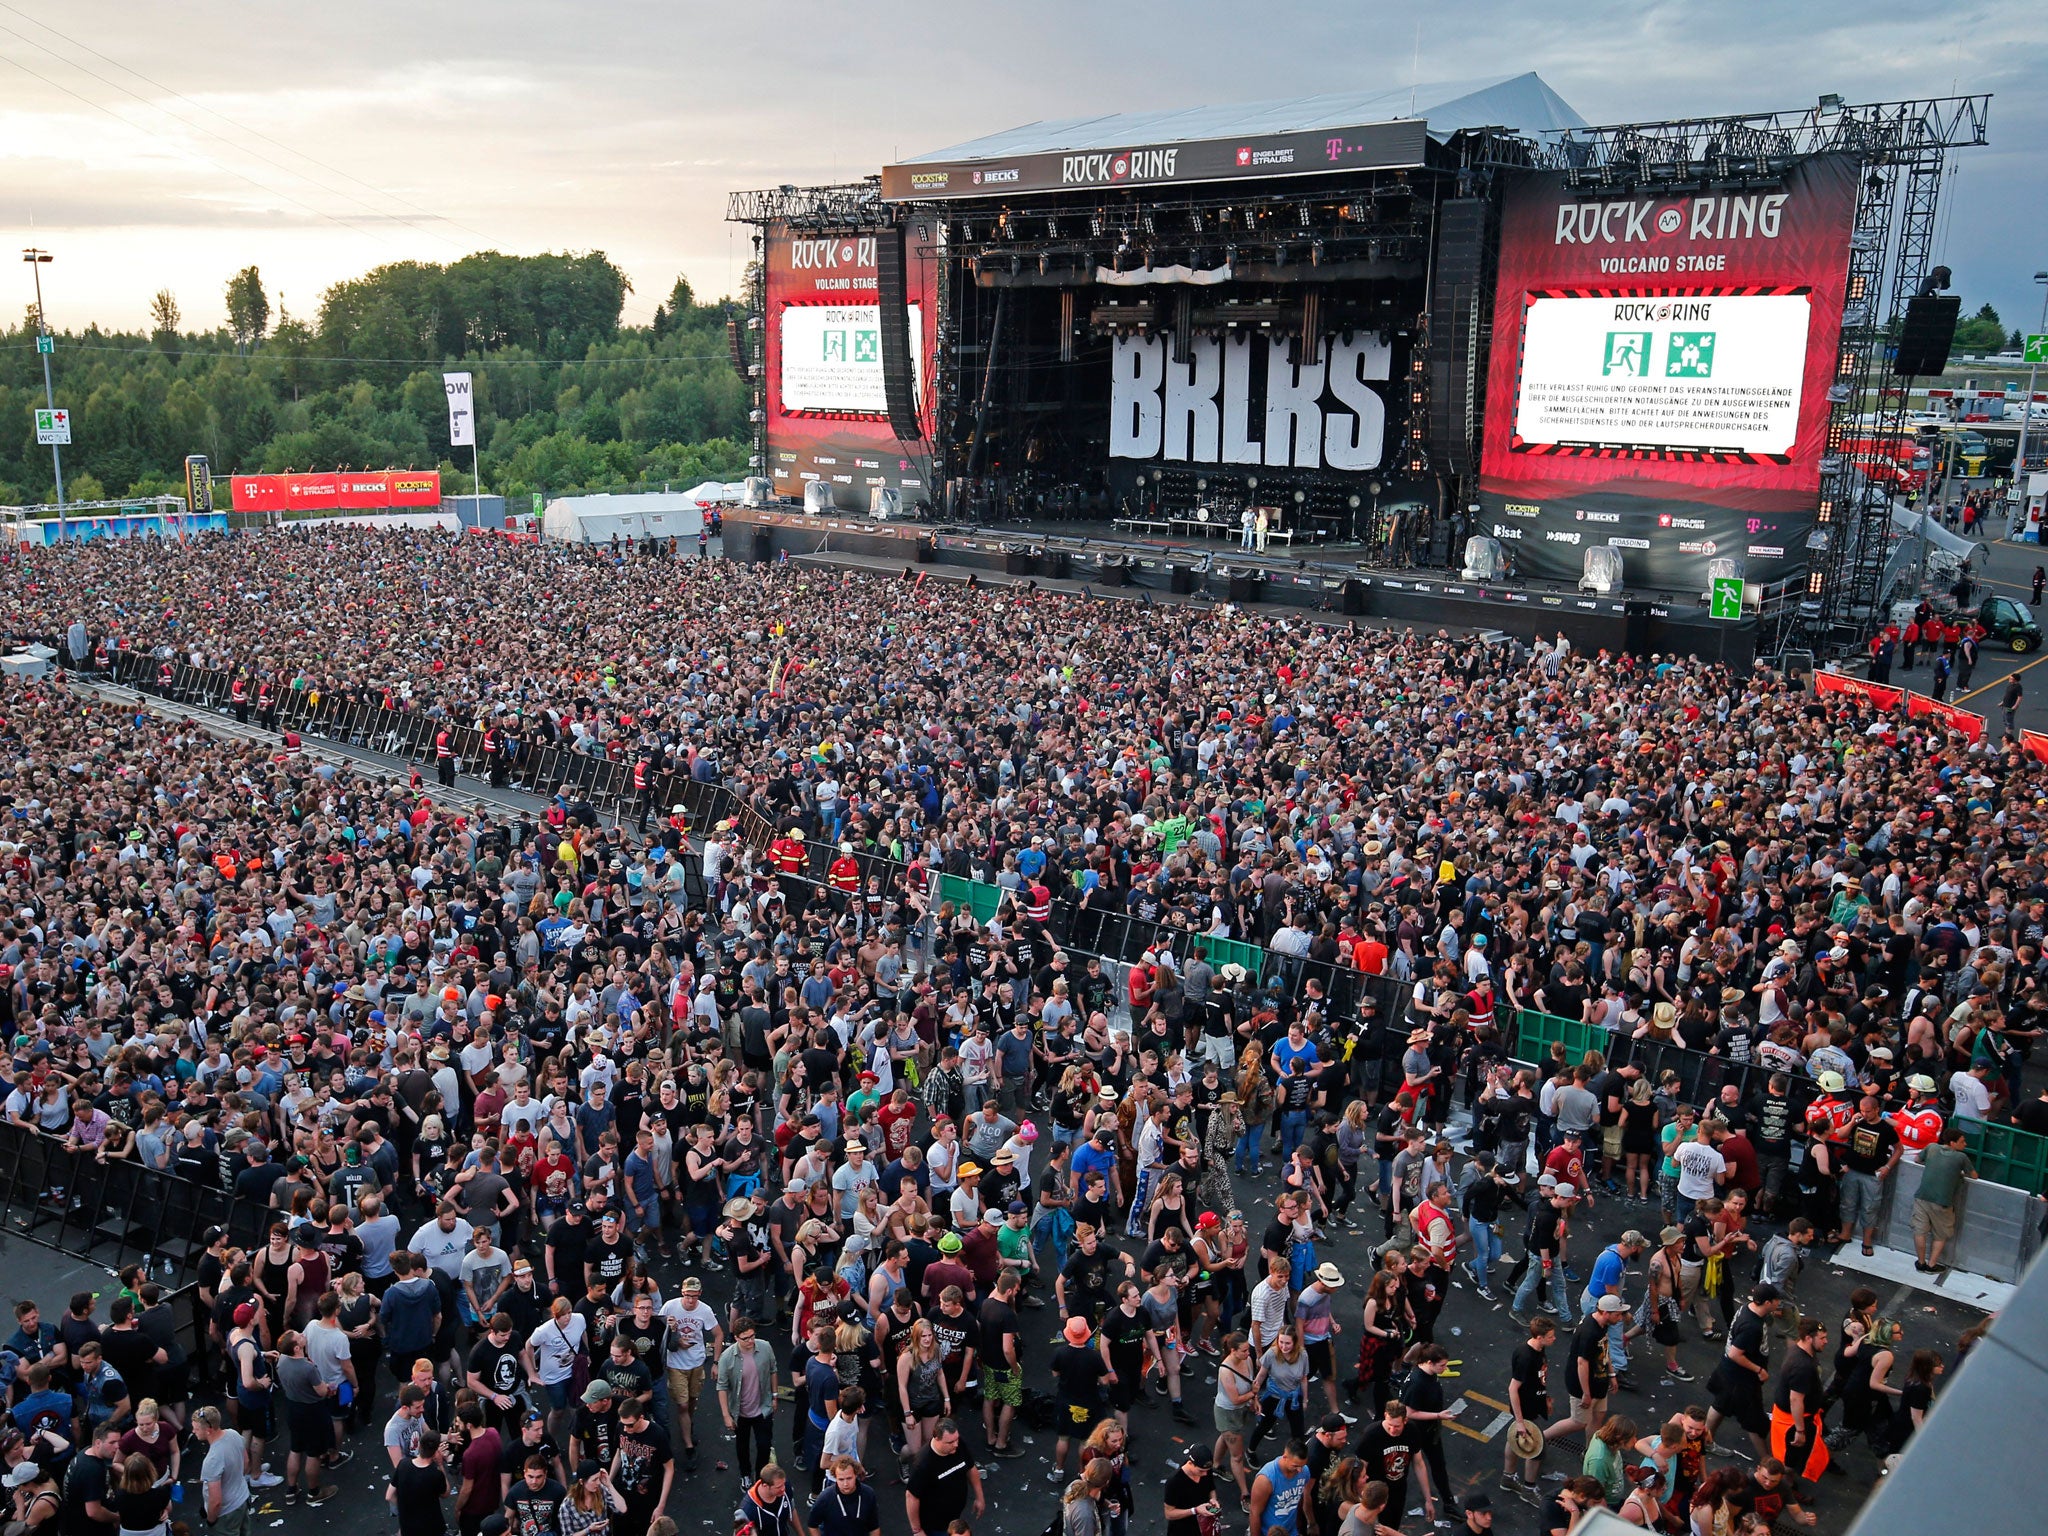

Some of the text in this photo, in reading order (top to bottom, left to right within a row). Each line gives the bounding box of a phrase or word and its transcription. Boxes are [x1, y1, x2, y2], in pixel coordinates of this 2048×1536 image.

[1252, 149, 1294, 158] ENGELBERT
[1062, 154, 1113, 183] ROCK
[1130, 149, 1178, 178] RING
[1252, 156, 1294, 164] STRAUSS
[911, 172, 948, 184] ROCKSTAR
[984, 170, 1019, 182] BECK'S
[1554, 200, 1655, 244] ROCK
[1689, 194, 1790, 240] RING
[792, 239, 840, 269] ROCK
[857, 238, 876, 268] RI
[1600, 255, 1726, 274] VOLCANO STAGE
[815, 278, 878, 290] VOLCANO STAGE
[826, 310, 874, 322] ROCK RING
[1614, 304, 1712, 321] ROCK RING
[1687, 386, 1792, 396] VERANSTALTUNGSGELÄNDE
[1528, 393, 1546, 401] ÜBER
[1635, 396, 1688, 405] NOTAUSGÄNGE
[1722, 400, 1790, 408] AUSGEWIESENEN
[1540, 417, 1618, 426] SICHERHEITSDIENSTES
[192, 462, 205, 509] ROCKSTAR
[1505, 504, 1540, 514] ROCKSTAR
[1586, 514, 1620, 522] BECK'S
[1554, 532, 1581, 544] SWR3
[1174, 826, 1185, 836] 22
[980, 1124, 1002, 1137] HCO
[933, 1323, 967, 1339] WACKEN
[1383, 1445, 1409, 1456] BROILERS
